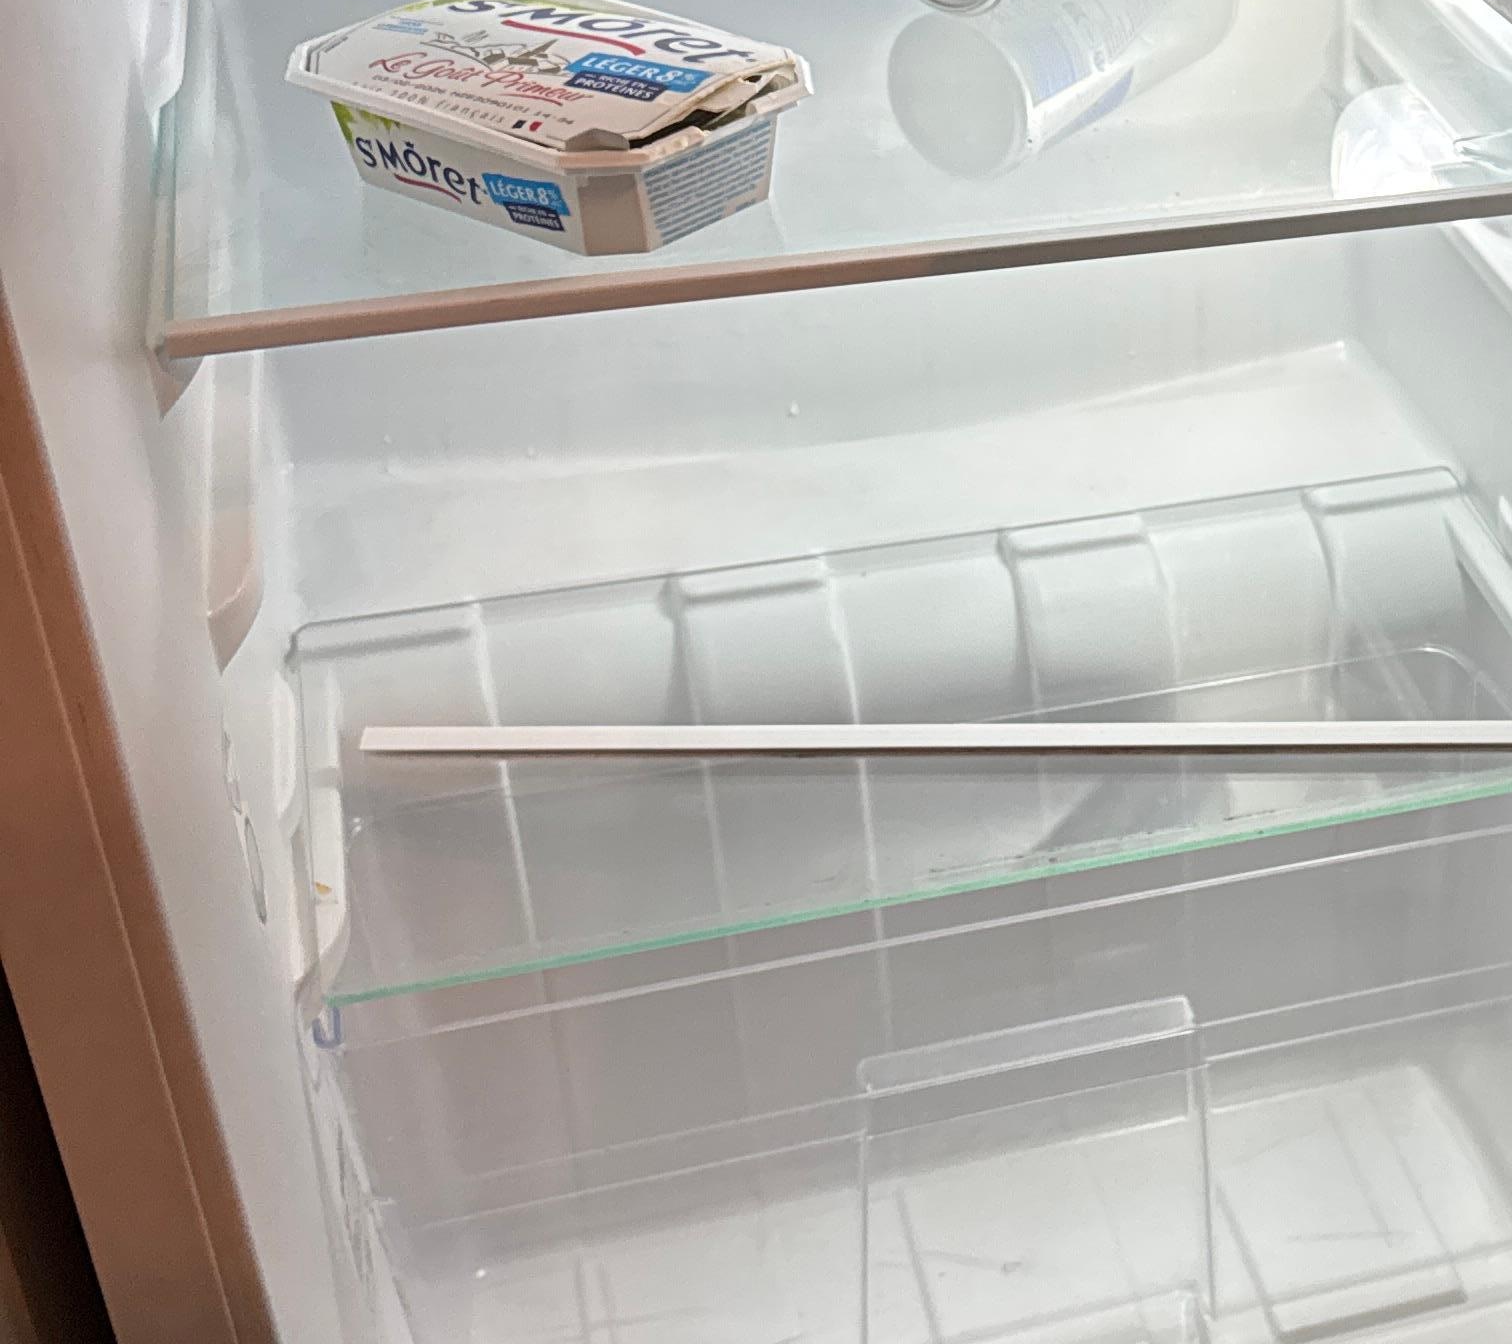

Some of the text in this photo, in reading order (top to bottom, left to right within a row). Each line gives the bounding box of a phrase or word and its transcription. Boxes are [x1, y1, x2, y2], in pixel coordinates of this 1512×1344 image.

[369, 52, 428, 73] Le
[404, 59, 482, 82] Goût
[481, 70, 594, 102] Primeur
[582, 57, 655, 82] LÉGER
[490, 180, 536, 201] LÉGER
